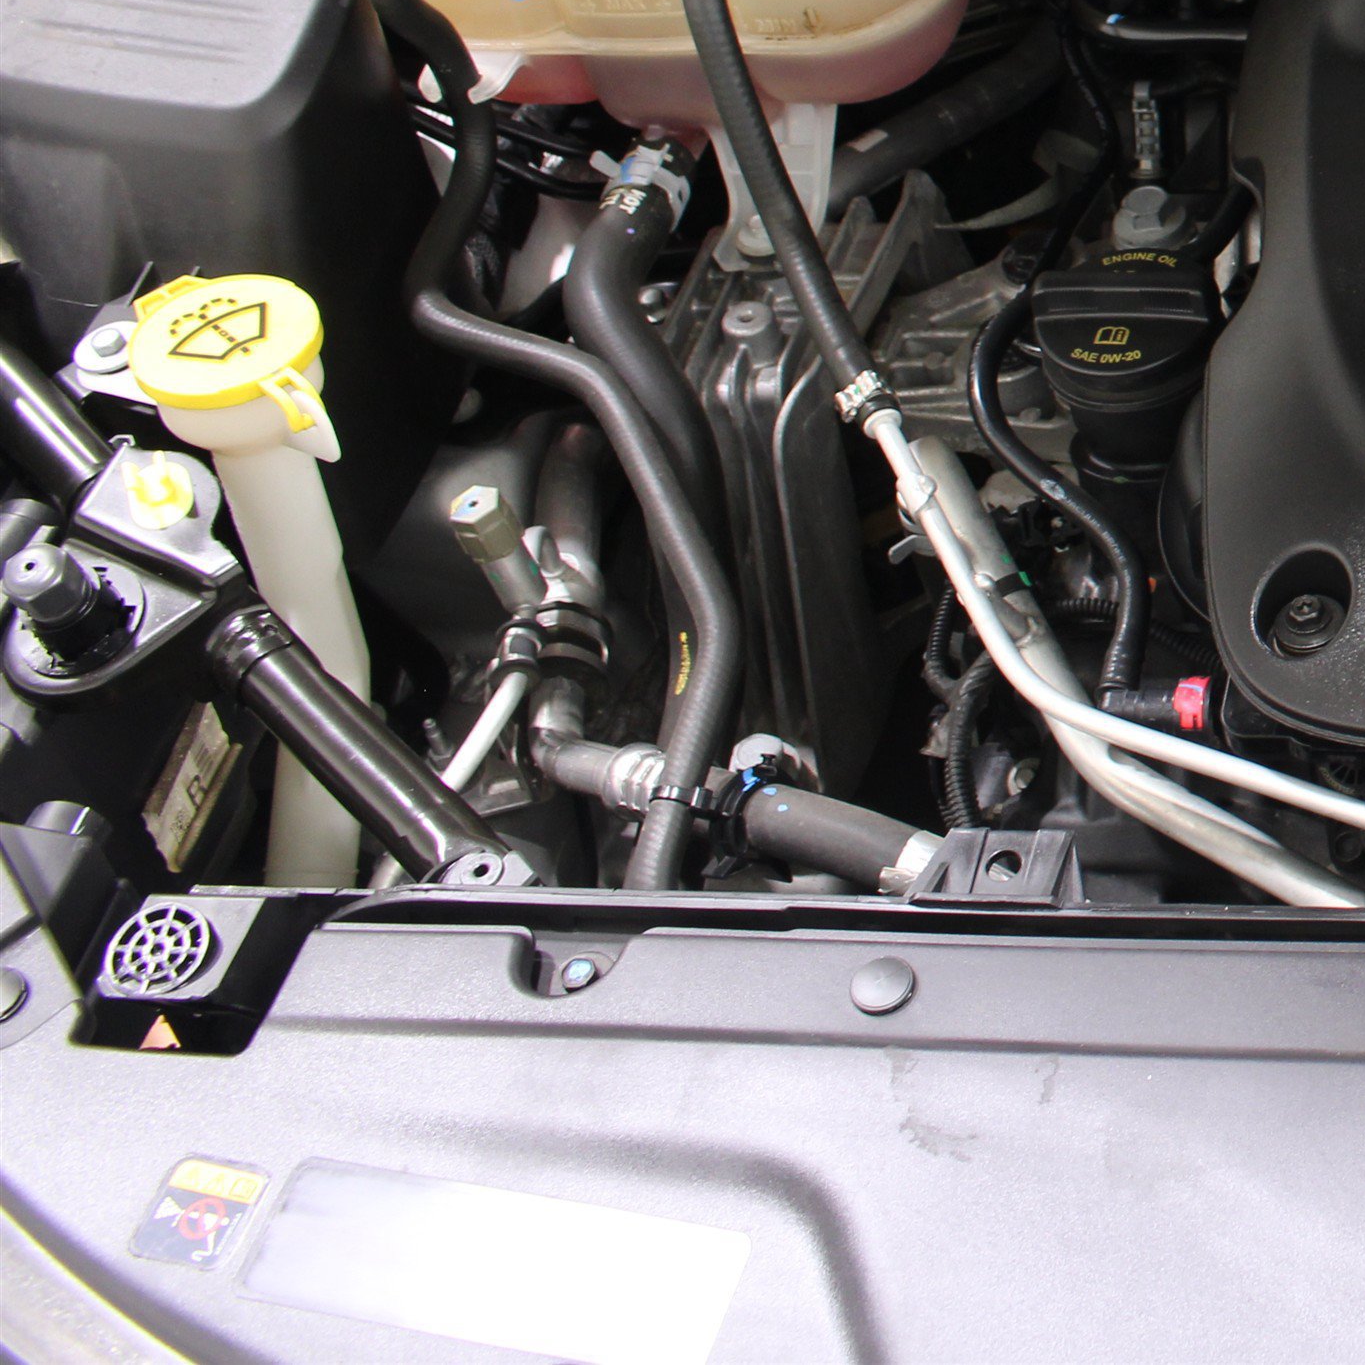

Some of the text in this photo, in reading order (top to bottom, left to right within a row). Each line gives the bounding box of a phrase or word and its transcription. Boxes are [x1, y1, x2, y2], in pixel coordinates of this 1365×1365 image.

[1102, 252, 1179, 267] ENGINE OIL
[1070, 348, 1142, 363] SAE 0W-20
